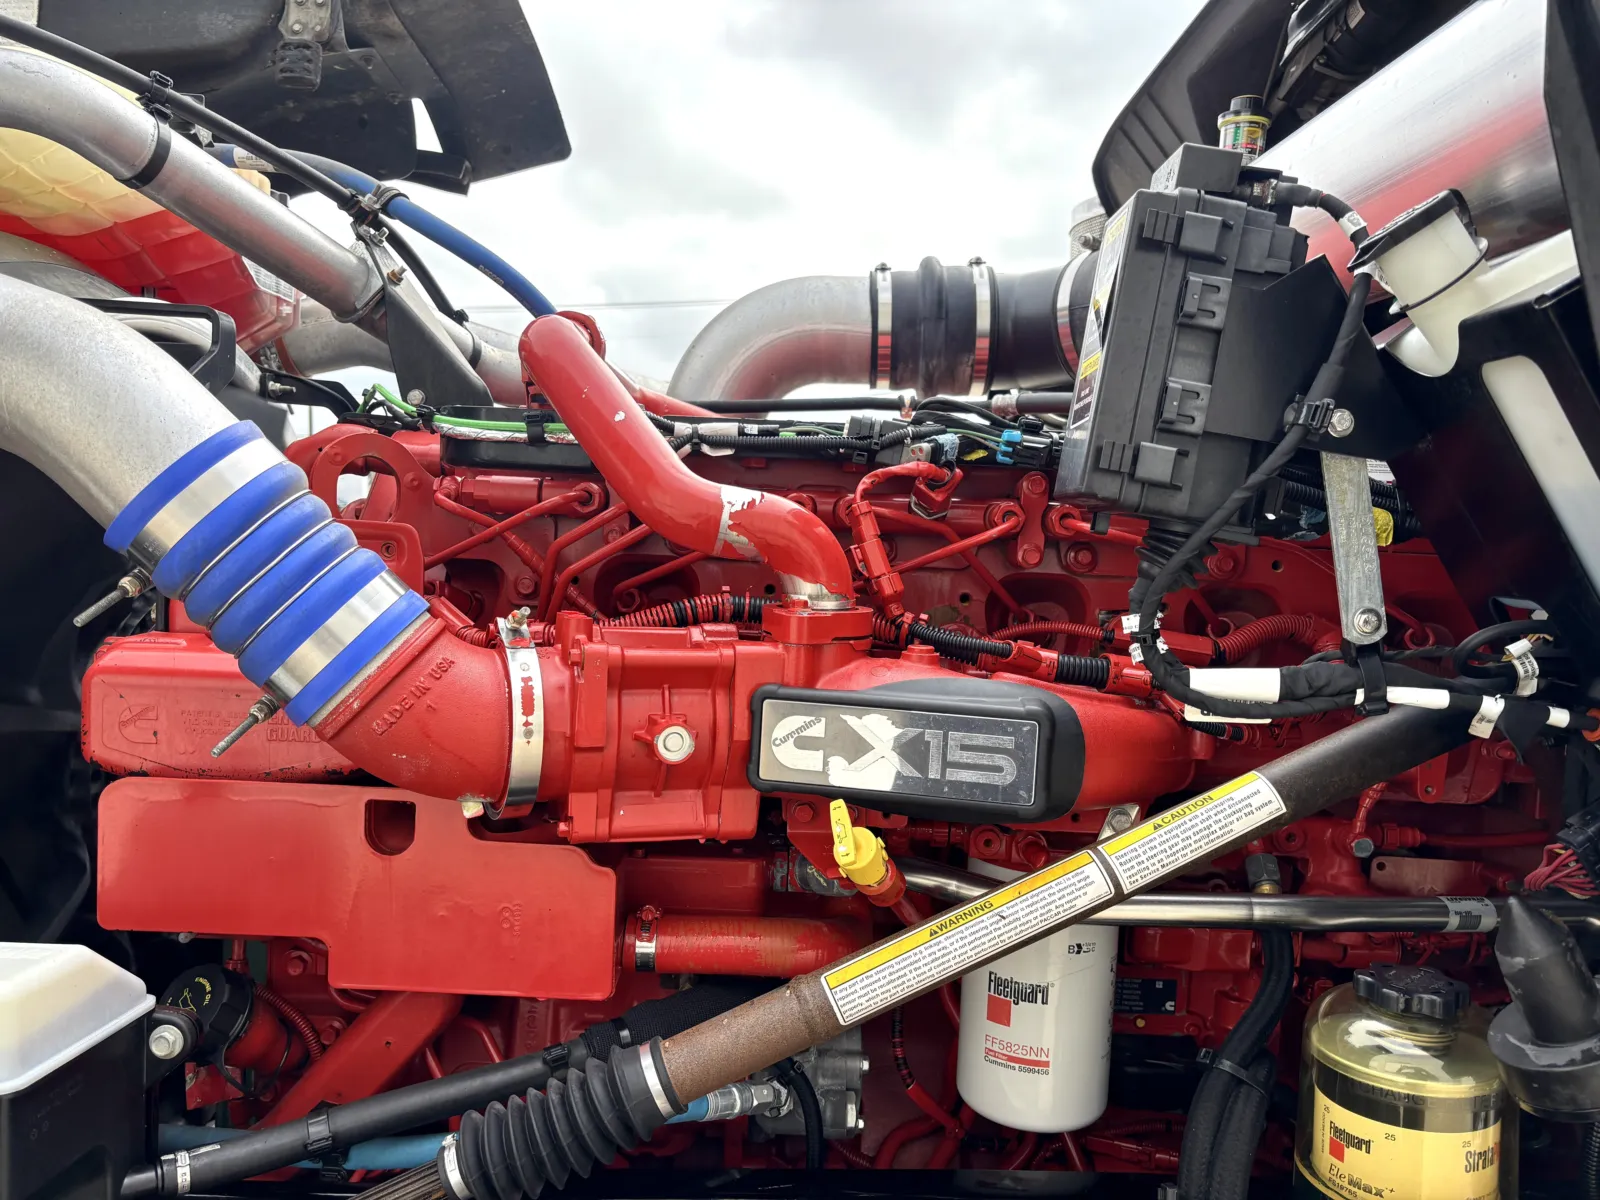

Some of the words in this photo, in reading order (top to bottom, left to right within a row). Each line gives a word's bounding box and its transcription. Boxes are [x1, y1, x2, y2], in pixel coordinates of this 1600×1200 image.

[371, 694, 414, 736] MADE
[411, 677, 432, 699] IN
[429, 656, 455, 681] USA
[772, 716, 823, 748] Cummins
[1160, 794, 1213, 825] CAUTION
[936, 899, 993, 932] WARNING
[1002, 909, 1019, 920] ensor
[195, 976, 212, 994] ENGINE
[203, 993, 211, 1006] OIL
[984, 1033, 1050, 1059] FF5825NN
[983, 1055, 1017, 1071] Cummins
[1018, 1066, 1050, 1076] 5599456
[1384, 1132, 1396, 1142] 25
[1461, 1140, 1472, 1148] 25
